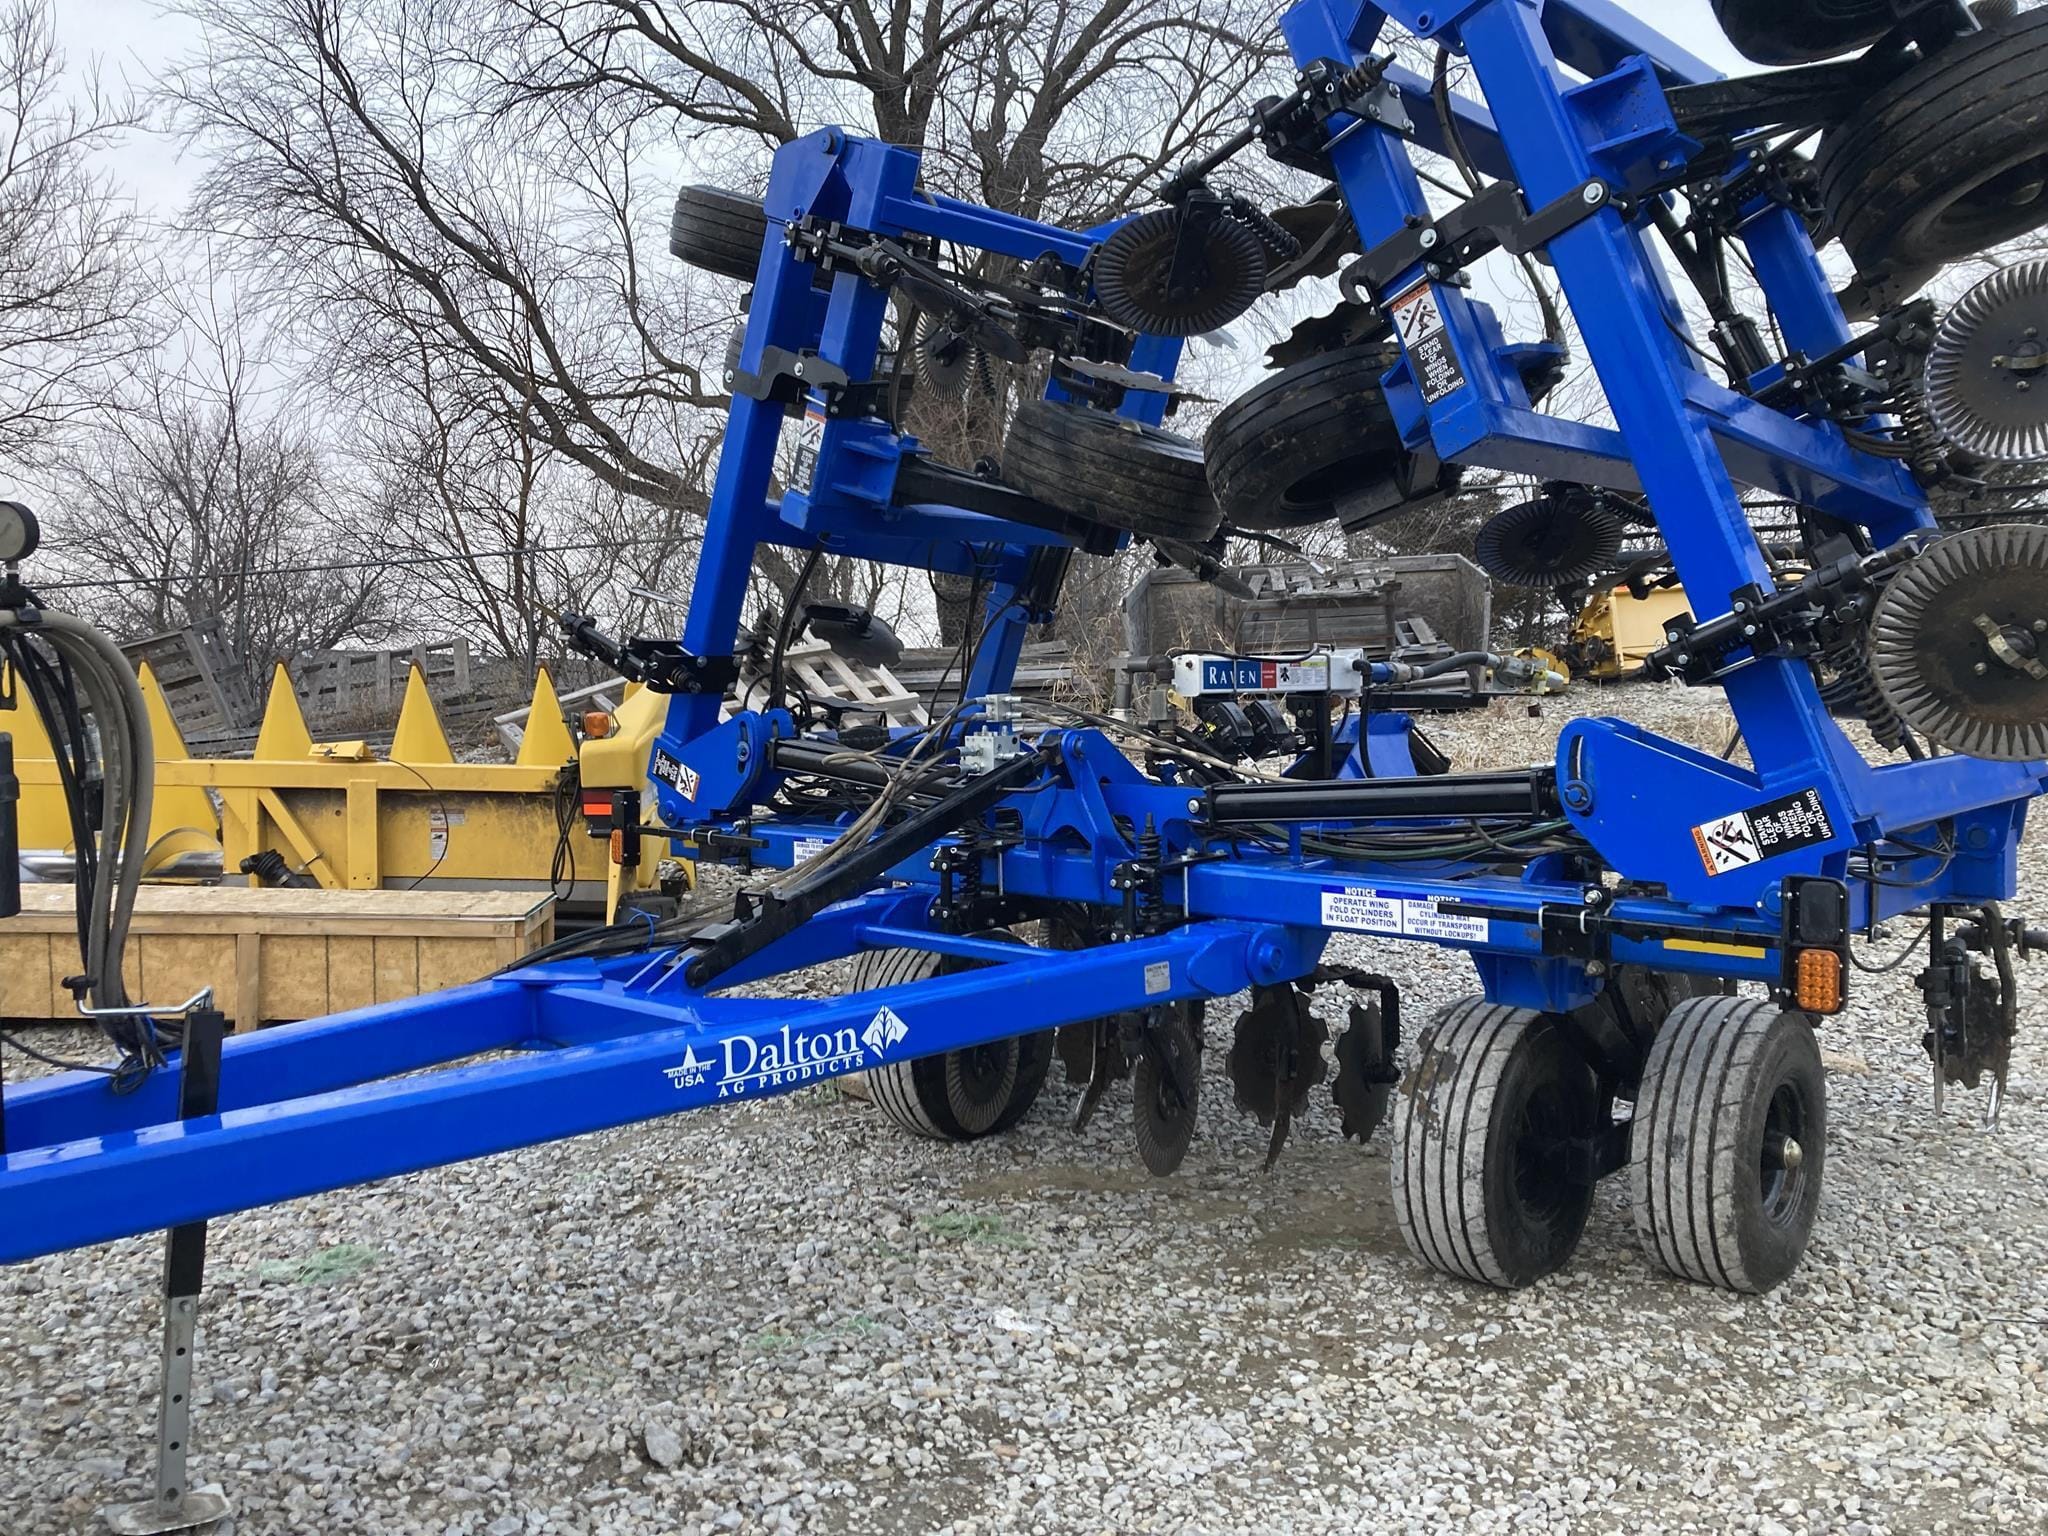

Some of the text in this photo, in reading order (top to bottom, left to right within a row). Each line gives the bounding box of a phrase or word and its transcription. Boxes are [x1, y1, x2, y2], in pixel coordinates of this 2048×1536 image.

[1418, 338, 1438, 354] STAND
[1420, 344, 1442, 360] CLEAR
[1425, 356, 1447, 373] WINGS
[1429, 354, 1437, 363] OF
[1426, 367, 1455, 388] FOLDING
[1428, 364, 1448, 378] WHEN
[1426, 377, 1464, 402] UNFOLDING
[1437, 380, 1448, 389] OR
[1209, 666, 1257, 685] RAVEN
[1786, 810, 1802, 835] WHEN
[1792, 801, 1813, 838] FOLDING
[1806, 790, 1832, 839] UNFOLDING
[1806, 811, 1816, 824] OR
[1762, 815, 1778, 844] CLEAR
[1773, 822, 1783, 833] OF
[1778, 810, 1795, 839] WINGS
[1754, 820, 1770, 846] STAND
[1345, 887, 1376, 897] NOTICE
[1333, 896, 1390, 910] OPERATE WING
[1408, 901, 1434, 910] DAMAGE
[1330, 905, 1393, 918] FOLD CYLINDERS
[1336, 914, 1359, 924] FLOAT
[1361, 918, 1397, 928] POSITION
[1408, 918, 1428, 926] OCCUR
[1438, 920, 1484, 932] TRANSPORTED
[1414, 927, 1476, 939] WITHOUT LOCKUPS!
[719, 1024, 860, 1080] Dalton
[667, 1068, 688, 1078] MADE
[689, 1066, 696, 1074] IN
[718, 1054, 864, 1098] AG PRODUCTS
[674, 1073, 704, 1089] USA
